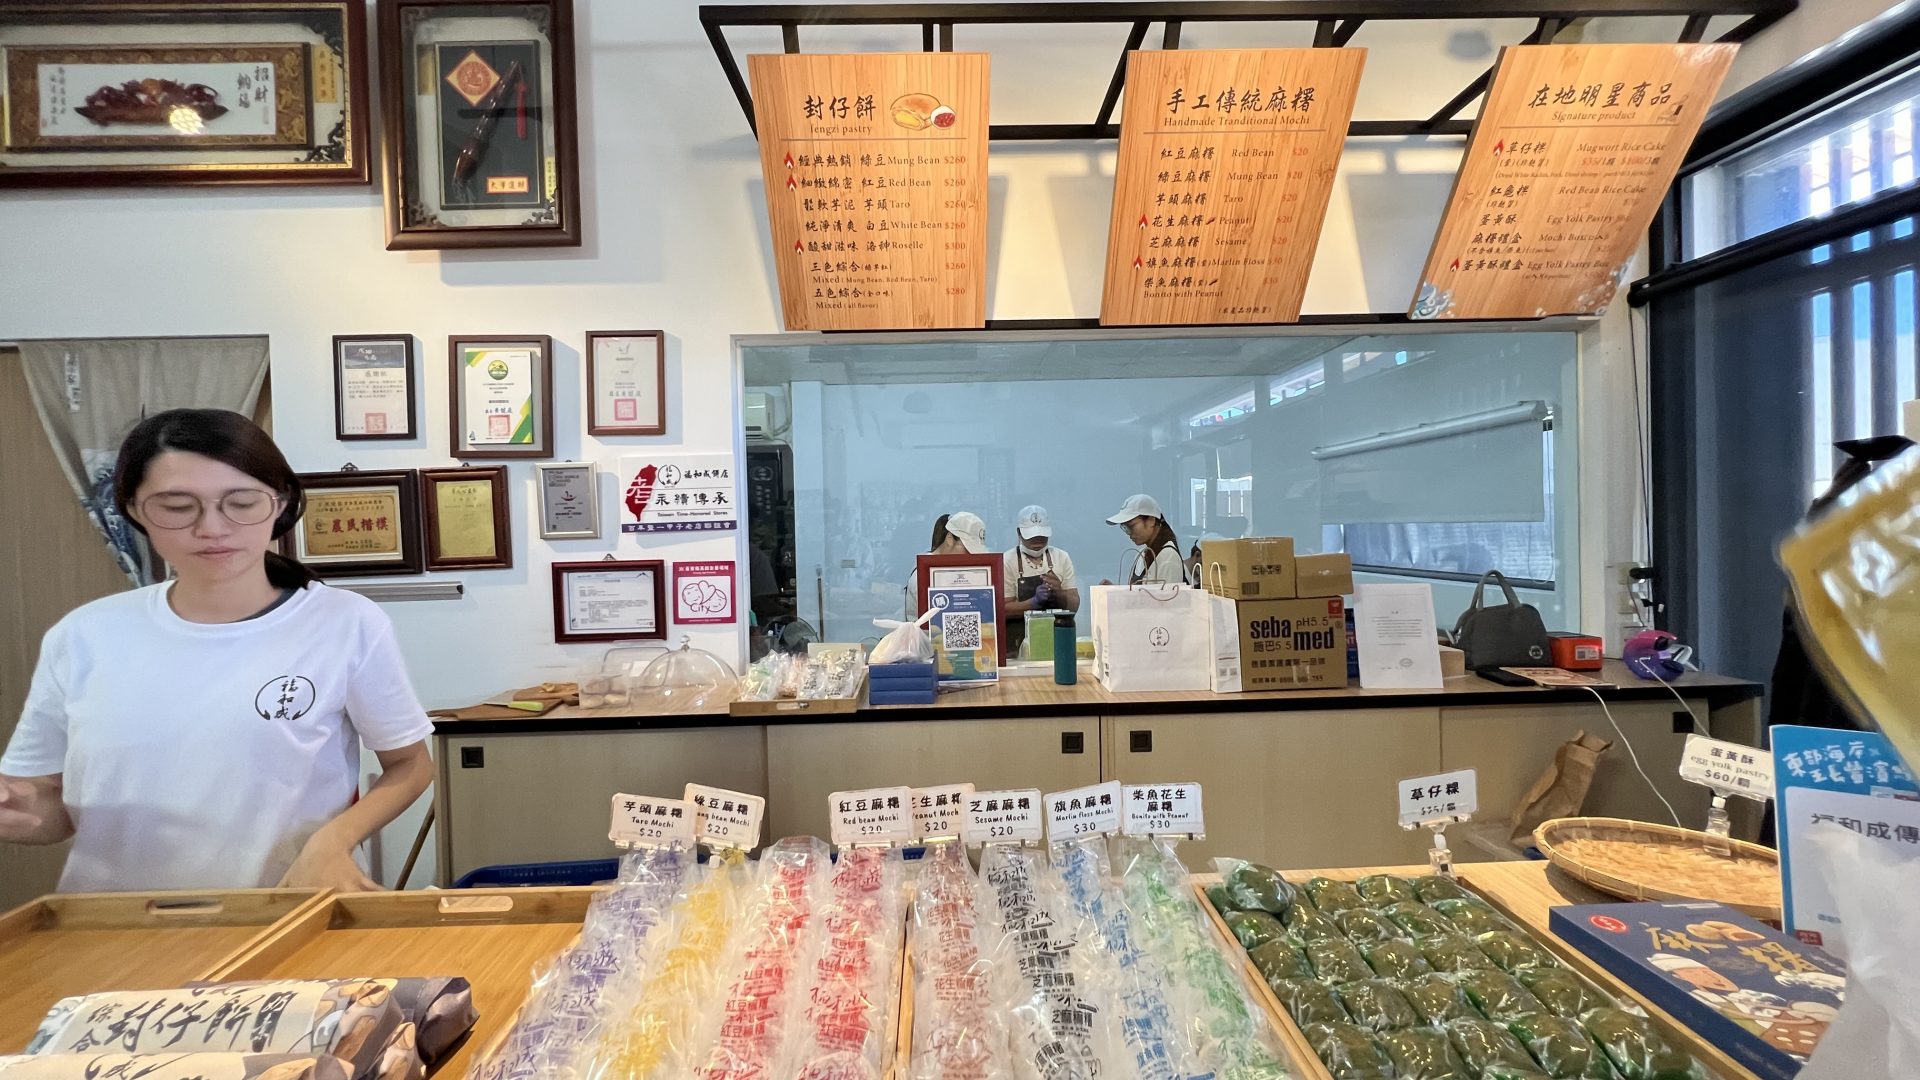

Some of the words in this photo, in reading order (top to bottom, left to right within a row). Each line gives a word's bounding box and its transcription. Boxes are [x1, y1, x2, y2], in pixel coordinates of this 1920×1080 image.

[1167, 86, 1315, 114] 手工傳統麻糬
[1528, 82, 1673, 109] 在地明星商品
[803, 94, 876, 121] 封仔餅
[1164, 117, 1215, 127] Handmade
[1280, 115, 1310, 125] Mochi
[1552, 111, 1597, 121] Signature
[1598, 111, 1637, 121] product
[842, 125, 872, 135] pastry
[1160, 147, 1215, 161] 紅豆麻糬
[1231, 149, 1249, 157] Red
[1252, 149, 1275, 157] Bean
[1292, 148, 1309, 157] $20
[1576, 143, 1620, 154] Mugwort
[1621, 143, 1643, 151] Rice
[1643, 142, 1667, 151] Cake
[798, 154, 851, 168] 經典熱銷
[888, 155, 914, 166] Mung
[917, 155, 940, 165] Bean
[944, 156, 966, 165] $260
[1227, 172, 1253, 182] Mung
[1256, 171, 1278, 180] Bean
[861, 177, 887, 189] 紅豆
[889, 178, 906, 187] Red
[908, 178, 932, 187] Bean
[944, 178, 966, 187] $260
[1558, 186, 1577, 194] Red
[1578, 186, 1600, 194] Bean
[1602, 186, 1625, 194] Rice
[1623, 185, 1647, 194] Cake
[864, 199, 889, 211] 芋頭
[891, 201, 911, 209] Taro
[944, 201, 966, 209] $260
[1155, 192, 1207, 206] 芋頭麻糬
[1223, 195, 1244, 203] Taro
[1281, 193, 1298, 201] $20
[1151, 214, 1203, 227] 花生麻糬
[1219, 216, 1249, 225] Peanut
[1276, 215, 1293, 224] $20
[1479, 213, 1517, 226] 蛋黃酥
[1546, 215, 1564, 224] Egg
[1566, 214, 1584, 223] Yolk
[1586, 215, 1614, 224] Pastry
[805, 220, 858, 233] 純淨清爽
[866, 220, 890, 232] 白豆
[891, 221, 918, 230] White
[920, 221, 943, 229] Bean
[944, 222, 966, 230] $260
[808, 240, 859, 252] 酸甜滋味
[892, 241, 924, 249] Roselle
[1149, 236, 1200, 248] 芝麻麻糬
[1215, 238, 1247, 246] Sesame
[1271, 237, 1288, 245] $20
[945, 262, 966, 270] $260
[1212, 258, 1240, 266] Marlin
[1463, 258, 1523, 271] 蛋黃酥禮盒
[1527, 261, 1543, 271] Egg
[1545, 260, 1562, 269] Yolk
[1564, 260, 1591, 270] Pastry
[813, 276, 840, 284] Mixed
[945, 287, 966, 295] $280
[1174, 290, 1193, 298] with
[1195, 289, 1224, 298] Peanut
[1250, 616, 1291, 639] seba
[1293, 627, 1334, 651] med
[1710, 747, 1755, 765] 蛋黃酥
[1782, 741, 1865, 777] 東部海岸
[1690, 754, 1709, 766] egg
[1711, 758, 1732, 772] yolk
[1735, 765, 1770, 782] pastry
[1132, 788, 1187, 801] 柴魚花生
[1411, 781, 1459, 800] 草仔粿
[839, 797, 900, 813] 紅豆麻糬
[970, 797, 1030, 813] 芝麻麻糬
[1054, 794, 1112, 812] 旗魚麻糬
[623, 801, 683, 819] 芋頭麻糬
[1095, 808, 1114, 817] Mochi
[1132, 812, 1151, 820] Bonito
[1152, 812, 1166, 820] with
[632, 816, 649, 825] Taro
[651, 818, 674, 828] Mochi
[711, 812, 728, 822] bean
[729, 816, 750, 827] Mochi
[843, 816, 857, 825] Red
[878, 814, 899, 822] Mochi
[975, 815, 1003, 824] Sesame
[1005, 813, 1029, 822] Mochi
[1149, 820, 1171, 829] $30
[707, 824, 728, 835] $20
[925, 821, 948, 832] $20
[990, 826, 1014, 837] $20
[1073, 822, 1096, 834] $30
[639, 828, 662, 838] $20
[104, 995, 265, 1052] 封仔餅
